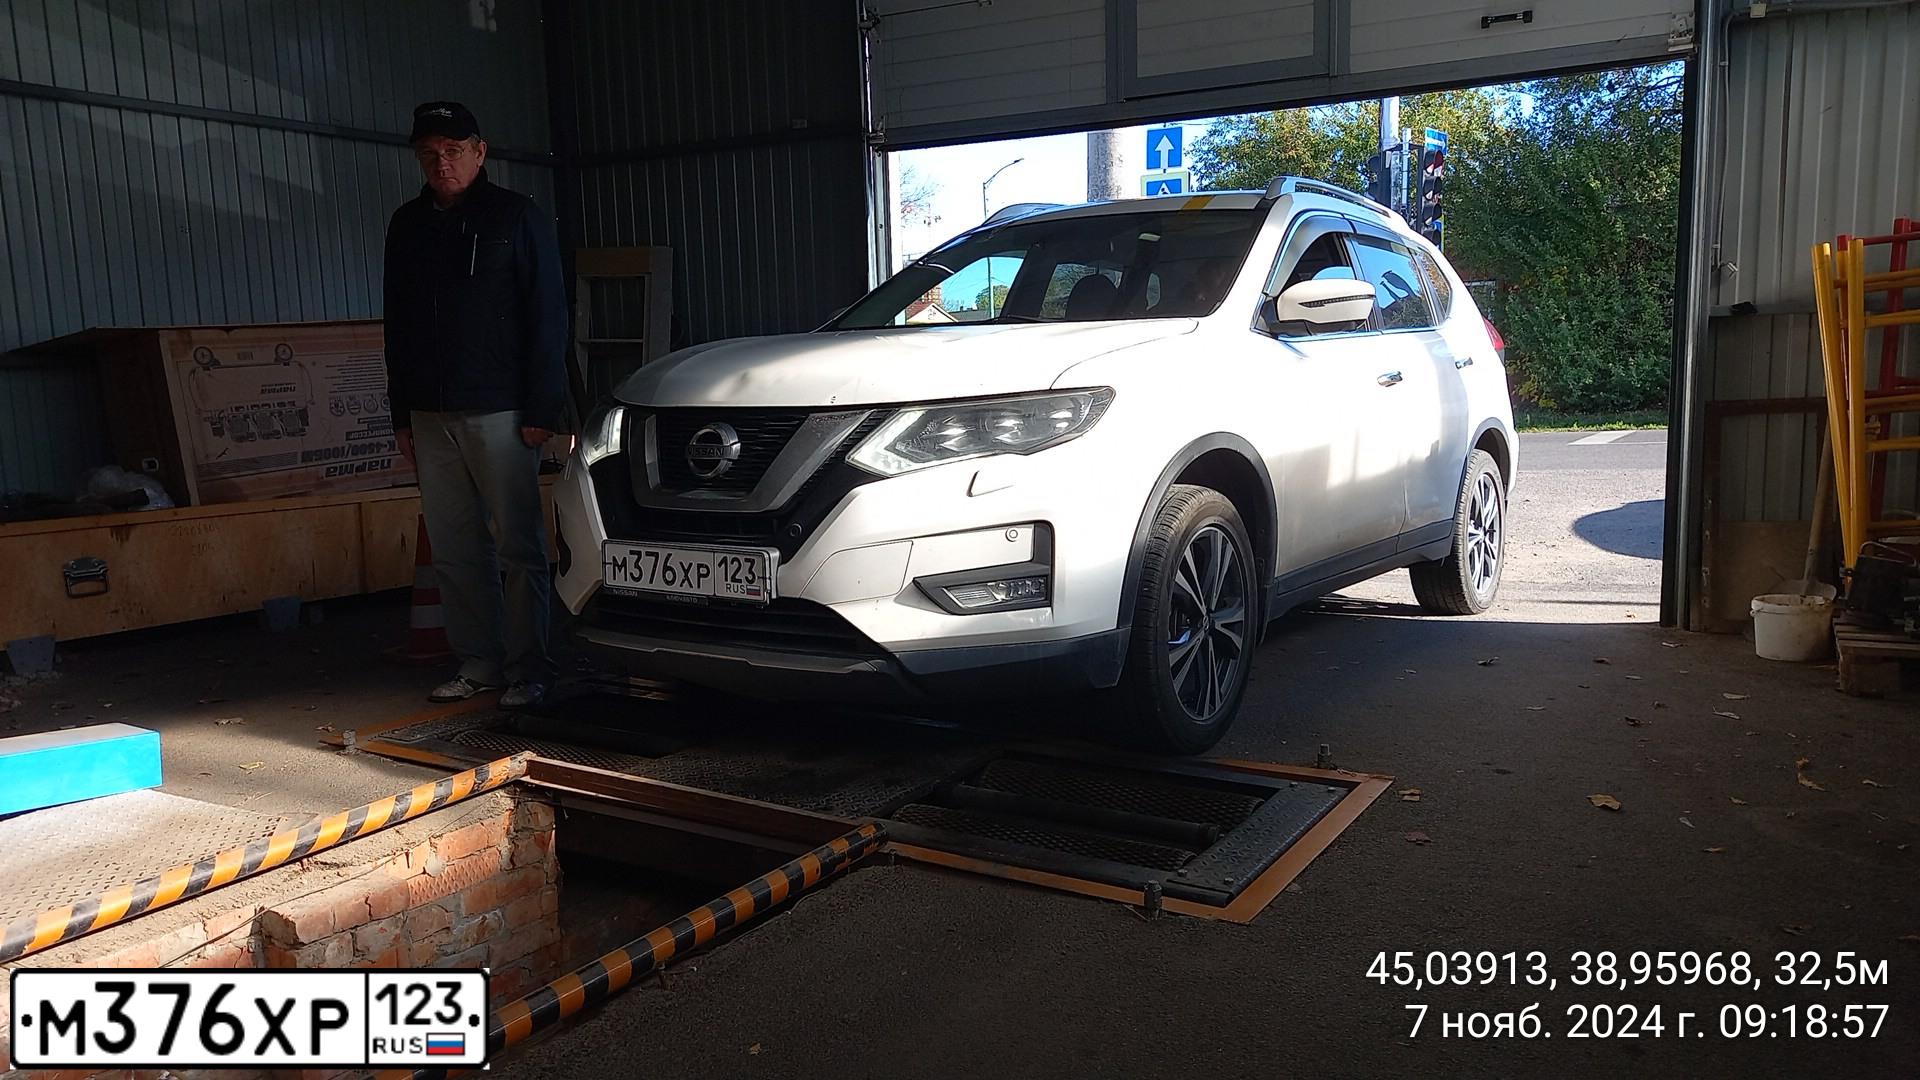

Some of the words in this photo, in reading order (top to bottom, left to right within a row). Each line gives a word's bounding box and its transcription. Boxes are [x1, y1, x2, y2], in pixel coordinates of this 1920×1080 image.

[612, 550, 711, 589] М376ХР
[717, 555, 757, 584] 123
[725, 583, 746, 594] RUS
